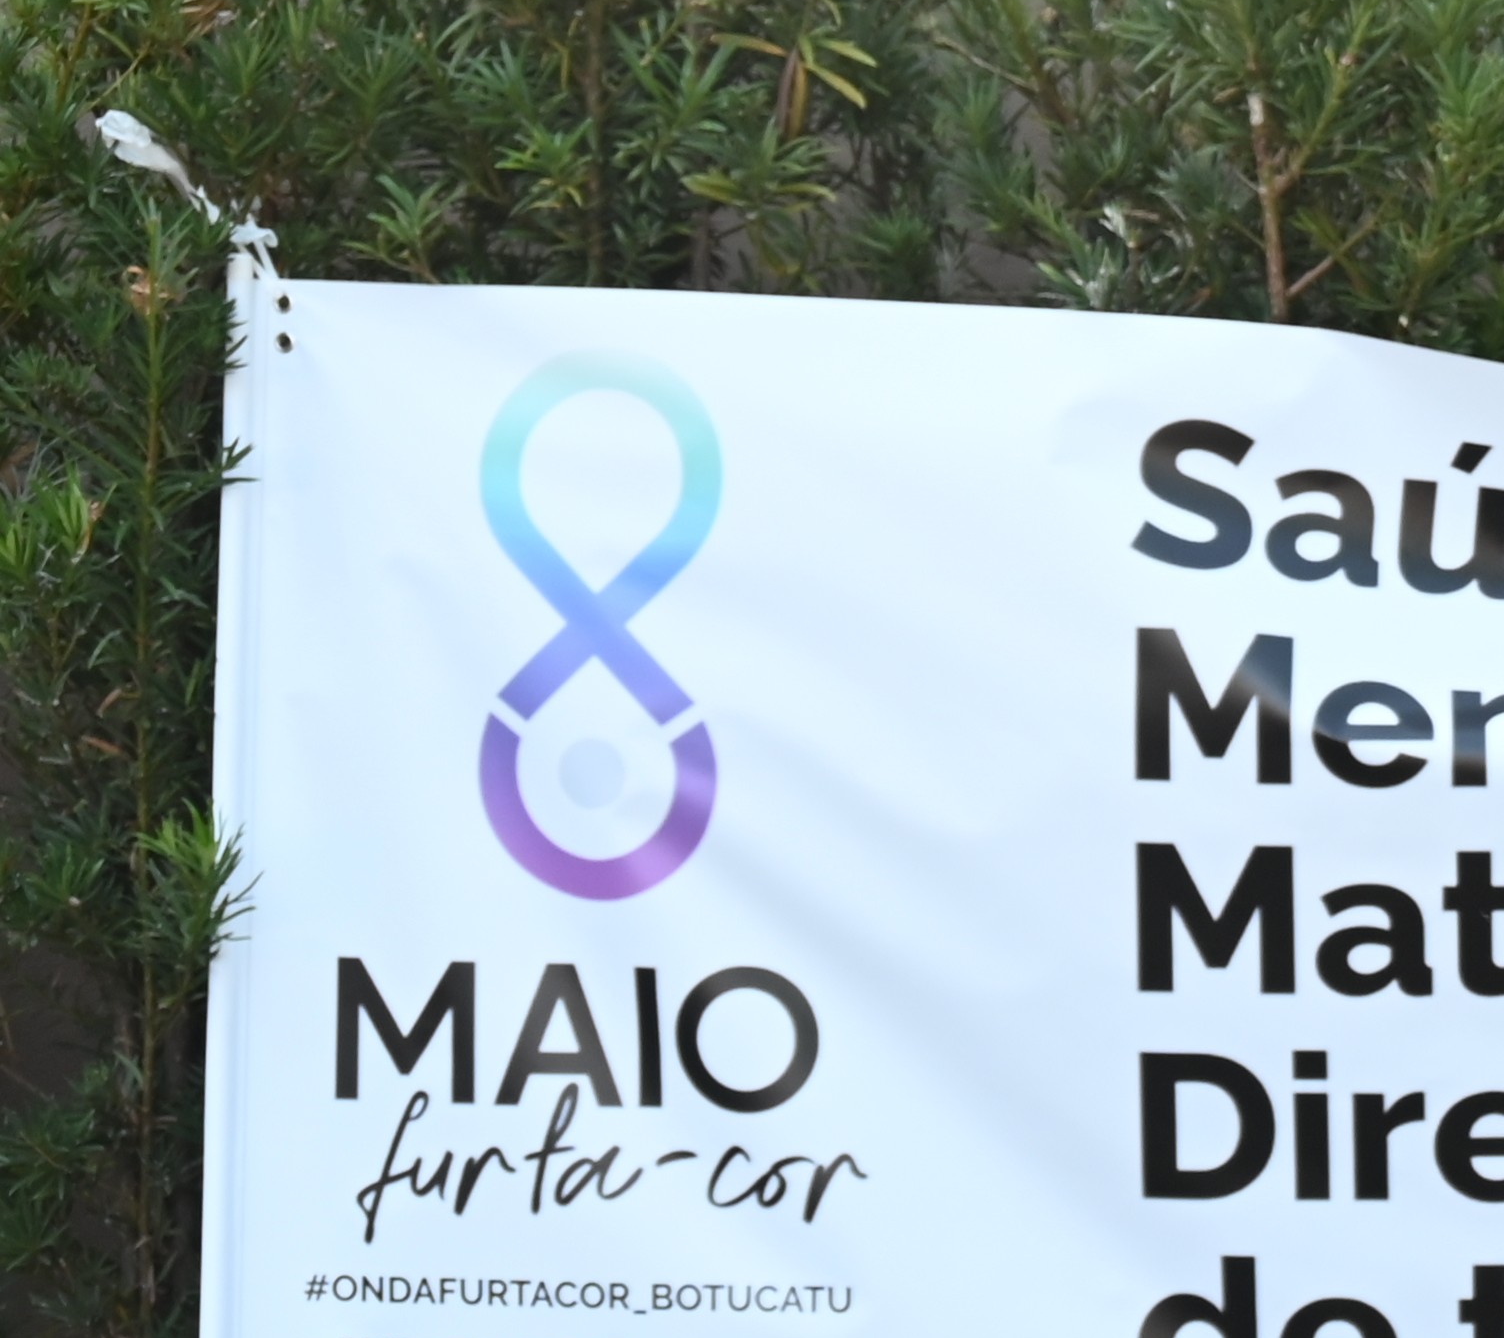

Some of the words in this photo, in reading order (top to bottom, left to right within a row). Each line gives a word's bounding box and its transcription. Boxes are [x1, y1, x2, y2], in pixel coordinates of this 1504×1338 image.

[335, 957, 819, 1114] MAIO
[356, 1083, 868, 1244] furta-cor
[304, 1275, 853, 1314] #ONDAFURTACOR_BOTUCATU
